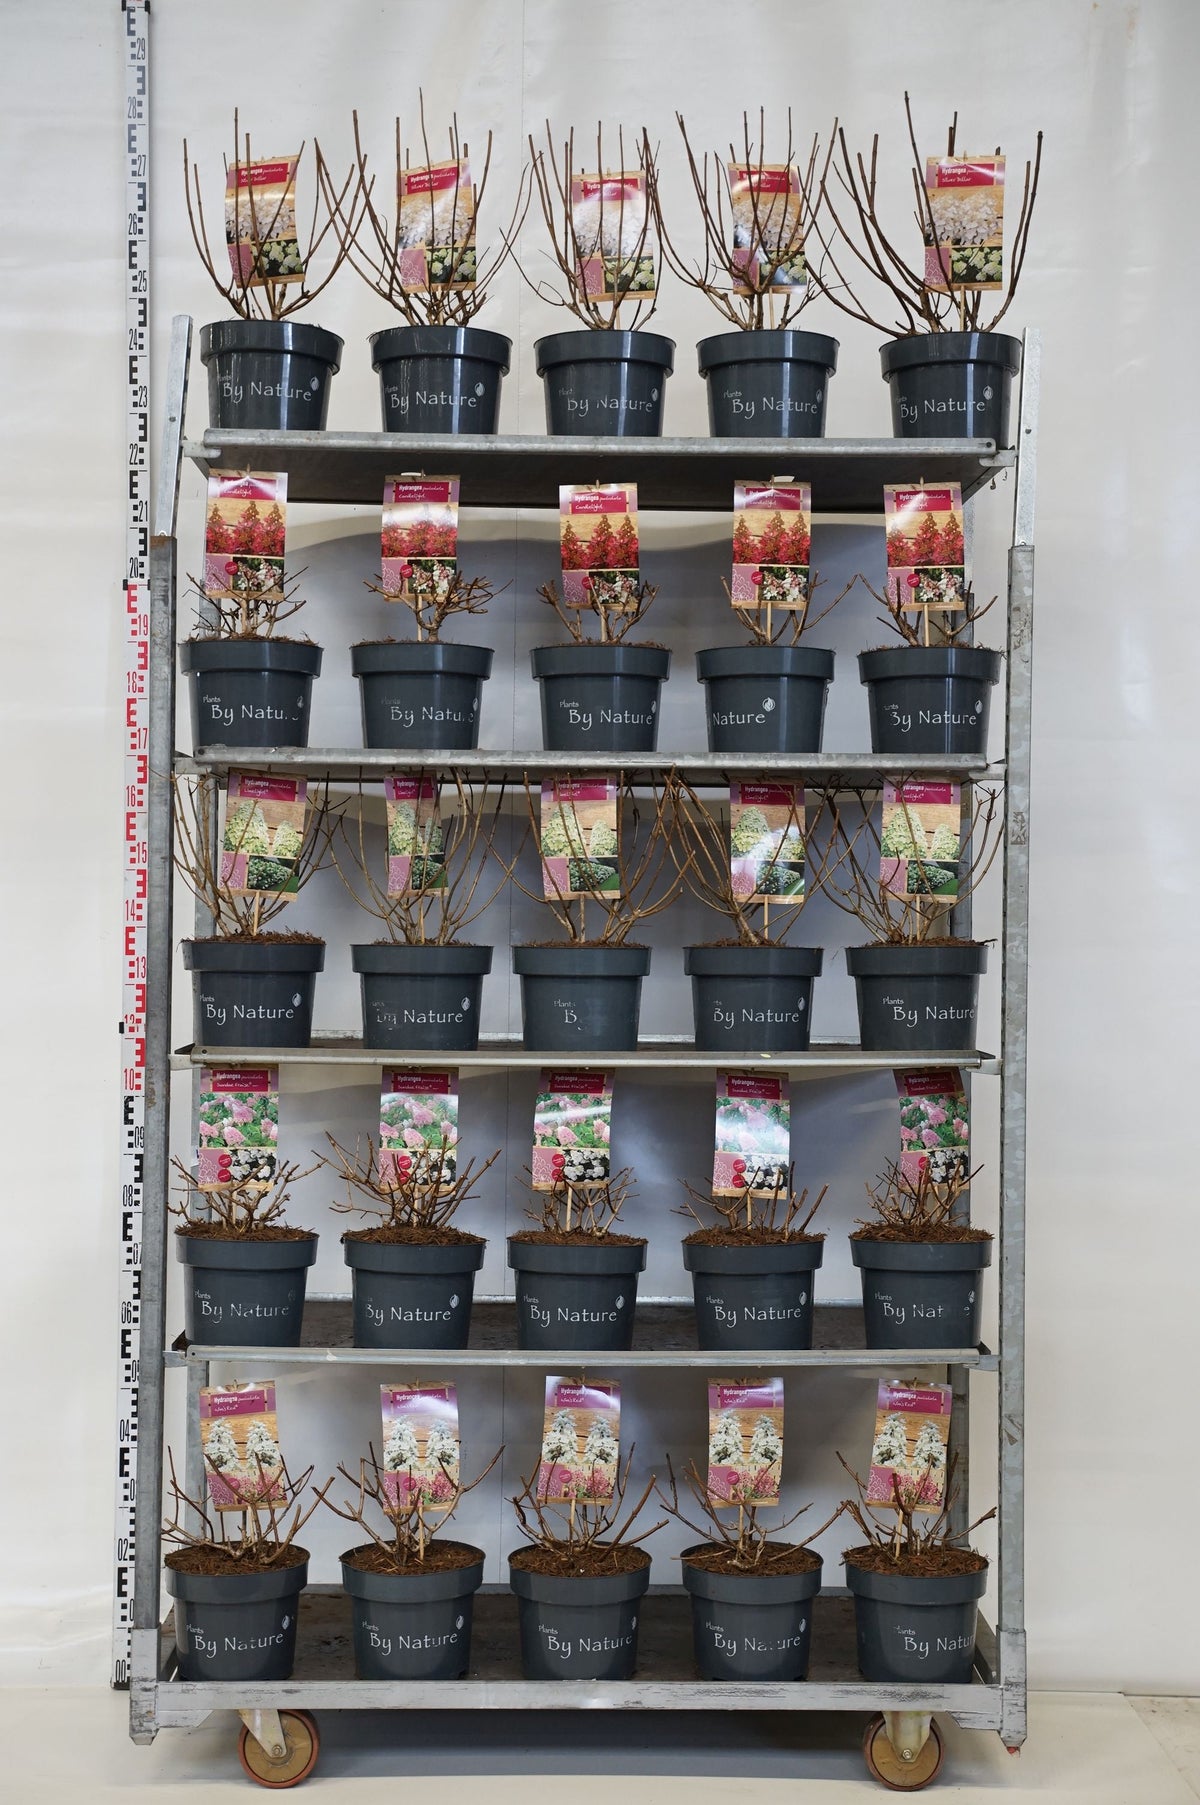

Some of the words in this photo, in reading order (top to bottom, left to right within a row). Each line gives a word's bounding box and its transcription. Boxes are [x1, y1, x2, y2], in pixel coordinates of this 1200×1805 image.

[136, 38, 146, 60] 29
[128, 96, 136, 119] 28
[137, 154, 146, 177] 27
[128, 213, 138, 236] 26
[138, 270, 147, 293] 25
[128, 328, 138, 351] 24
[138, 386, 148, 408] 23
[222, 382, 244, 404] By
[250, 382, 312, 402] Nature
[390, 394, 410, 414] By
[415, 391, 477, 408] Nature
[596, 396, 653, 413] Nature
[732, 398, 755, 420] By
[762, 397, 818, 414] Nature
[900, 404, 919, 423] By
[924, 399, 986, 414] Nature
[129, 443, 138, 465] 22
[138, 500, 148, 522] 21
[129, 557, 138, 579] 20
[137, 614, 149, 636] 19
[126, 671, 137, 693] 18
[202, 695, 222, 704] Plants
[559, 699, 580, 708] Plants
[211, 704, 234, 726] By
[391, 706, 414, 728] By
[569, 709, 592, 731] By
[712, 710, 767, 726] Nature
[919, 710, 977, 725] Nature
[137, 727, 148, 749] 17
[126, 785, 136, 807] 16
[136, 841, 147, 864] 15
[125, 899, 136, 921] 14
[136, 956, 146, 978] 13
[882, 996, 905, 1006] Plants
[206, 1004, 227, 1026] By
[233, 1004, 295, 1019] Nature
[403, 1010, 464, 1025] Nature
[712, 1008, 735, 1030] By
[741, 1009, 800, 1023] Nature
[893, 1006, 918, 1028] By
[925, 1006, 976, 1021] Nature
[124, 1068, 134, 1090] 10
[134, 1126, 144, 1148] 09
[123, 1184, 133, 1207] 08
[121, 1302, 132, 1324] 06
[201, 1301, 223, 1324] By
[391, 1307, 452, 1321] Nature
[530, 1305, 551, 1328] By
[557, 1308, 618, 1322] Nature
[714, 1305, 737, 1328] By
[744, 1306, 802, 1321] Nature
[883, 1302, 905, 1325] By
[213, 1396, 238, 1404] Hydrangea
[120, 1419, 130, 1442] 04
[118, 1538, 128, 1561] 02
[538, 1624, 559, 1636] Plants
[194, 1635, 218, 1659] By
[370, 1632, 392, 1656] By
[399, 1632, 458, 1650] Nature
[548, 1635, 572, 1659] By
[579, 1634, 633, 1653] Nature
[714, 1633, 737, 1657] By
[904, 1636, 930, 1660] By
[116, 1659, 126, 1682] 00
